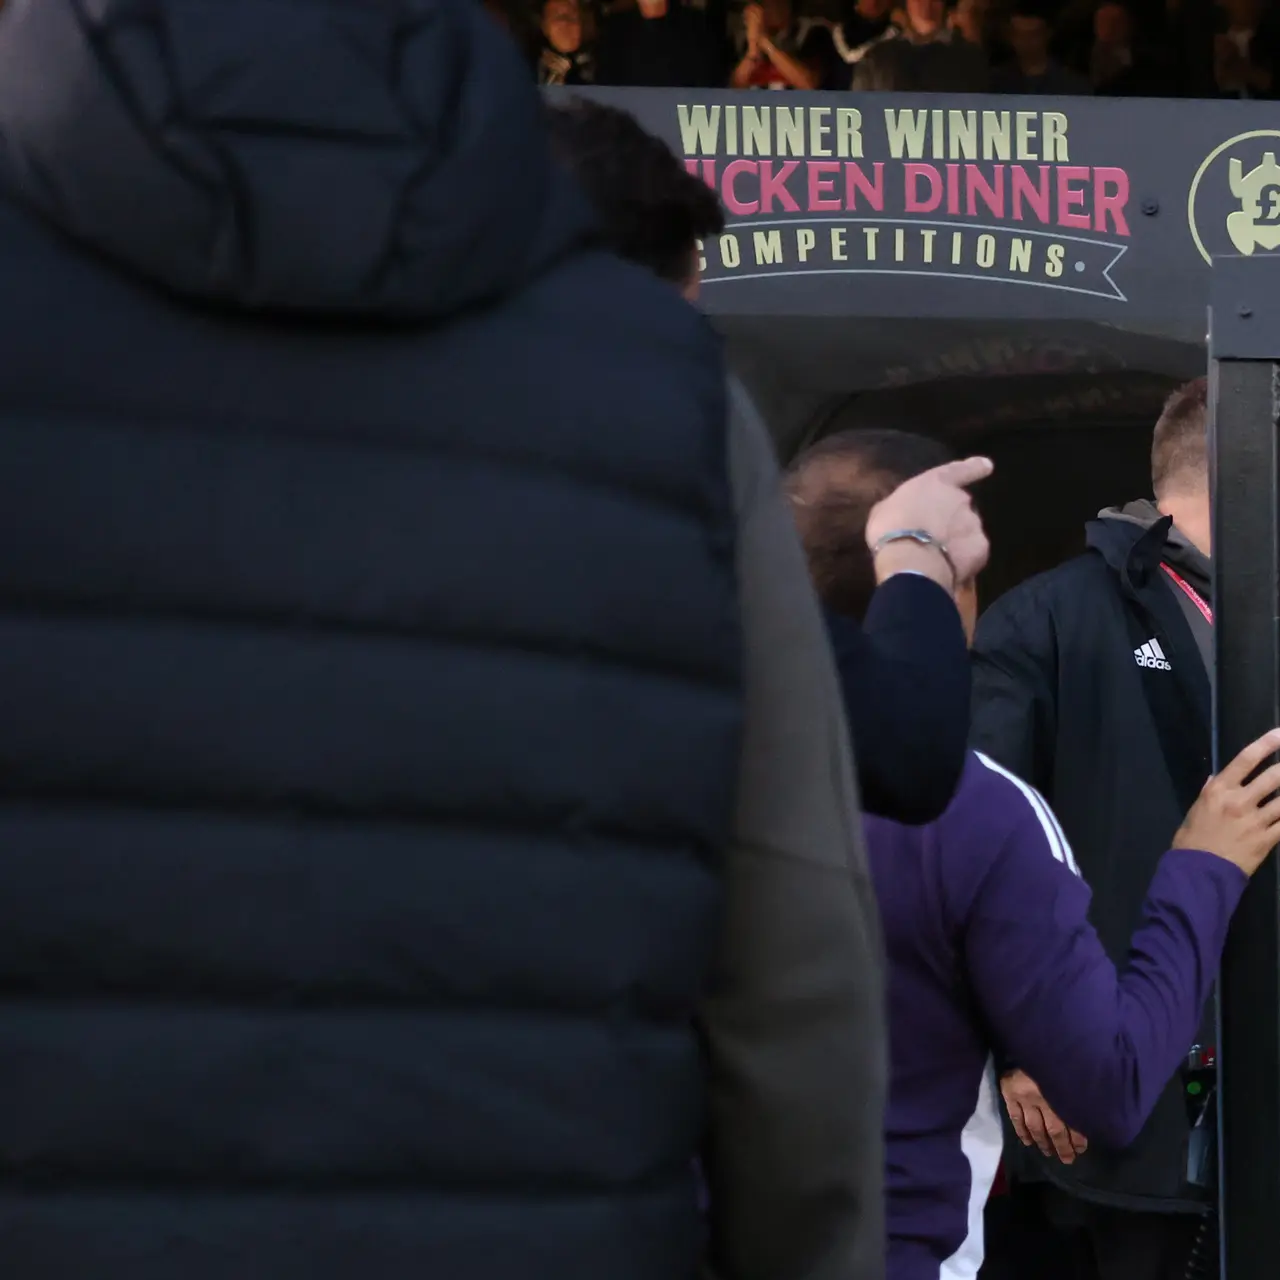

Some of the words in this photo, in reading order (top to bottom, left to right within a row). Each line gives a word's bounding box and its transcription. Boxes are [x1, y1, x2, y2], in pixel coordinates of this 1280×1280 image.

[677, 104, 864, 159] WINNER
[885, 108, 1069, 163] WINNER
[904, 162, 1131, 237] DINNER
